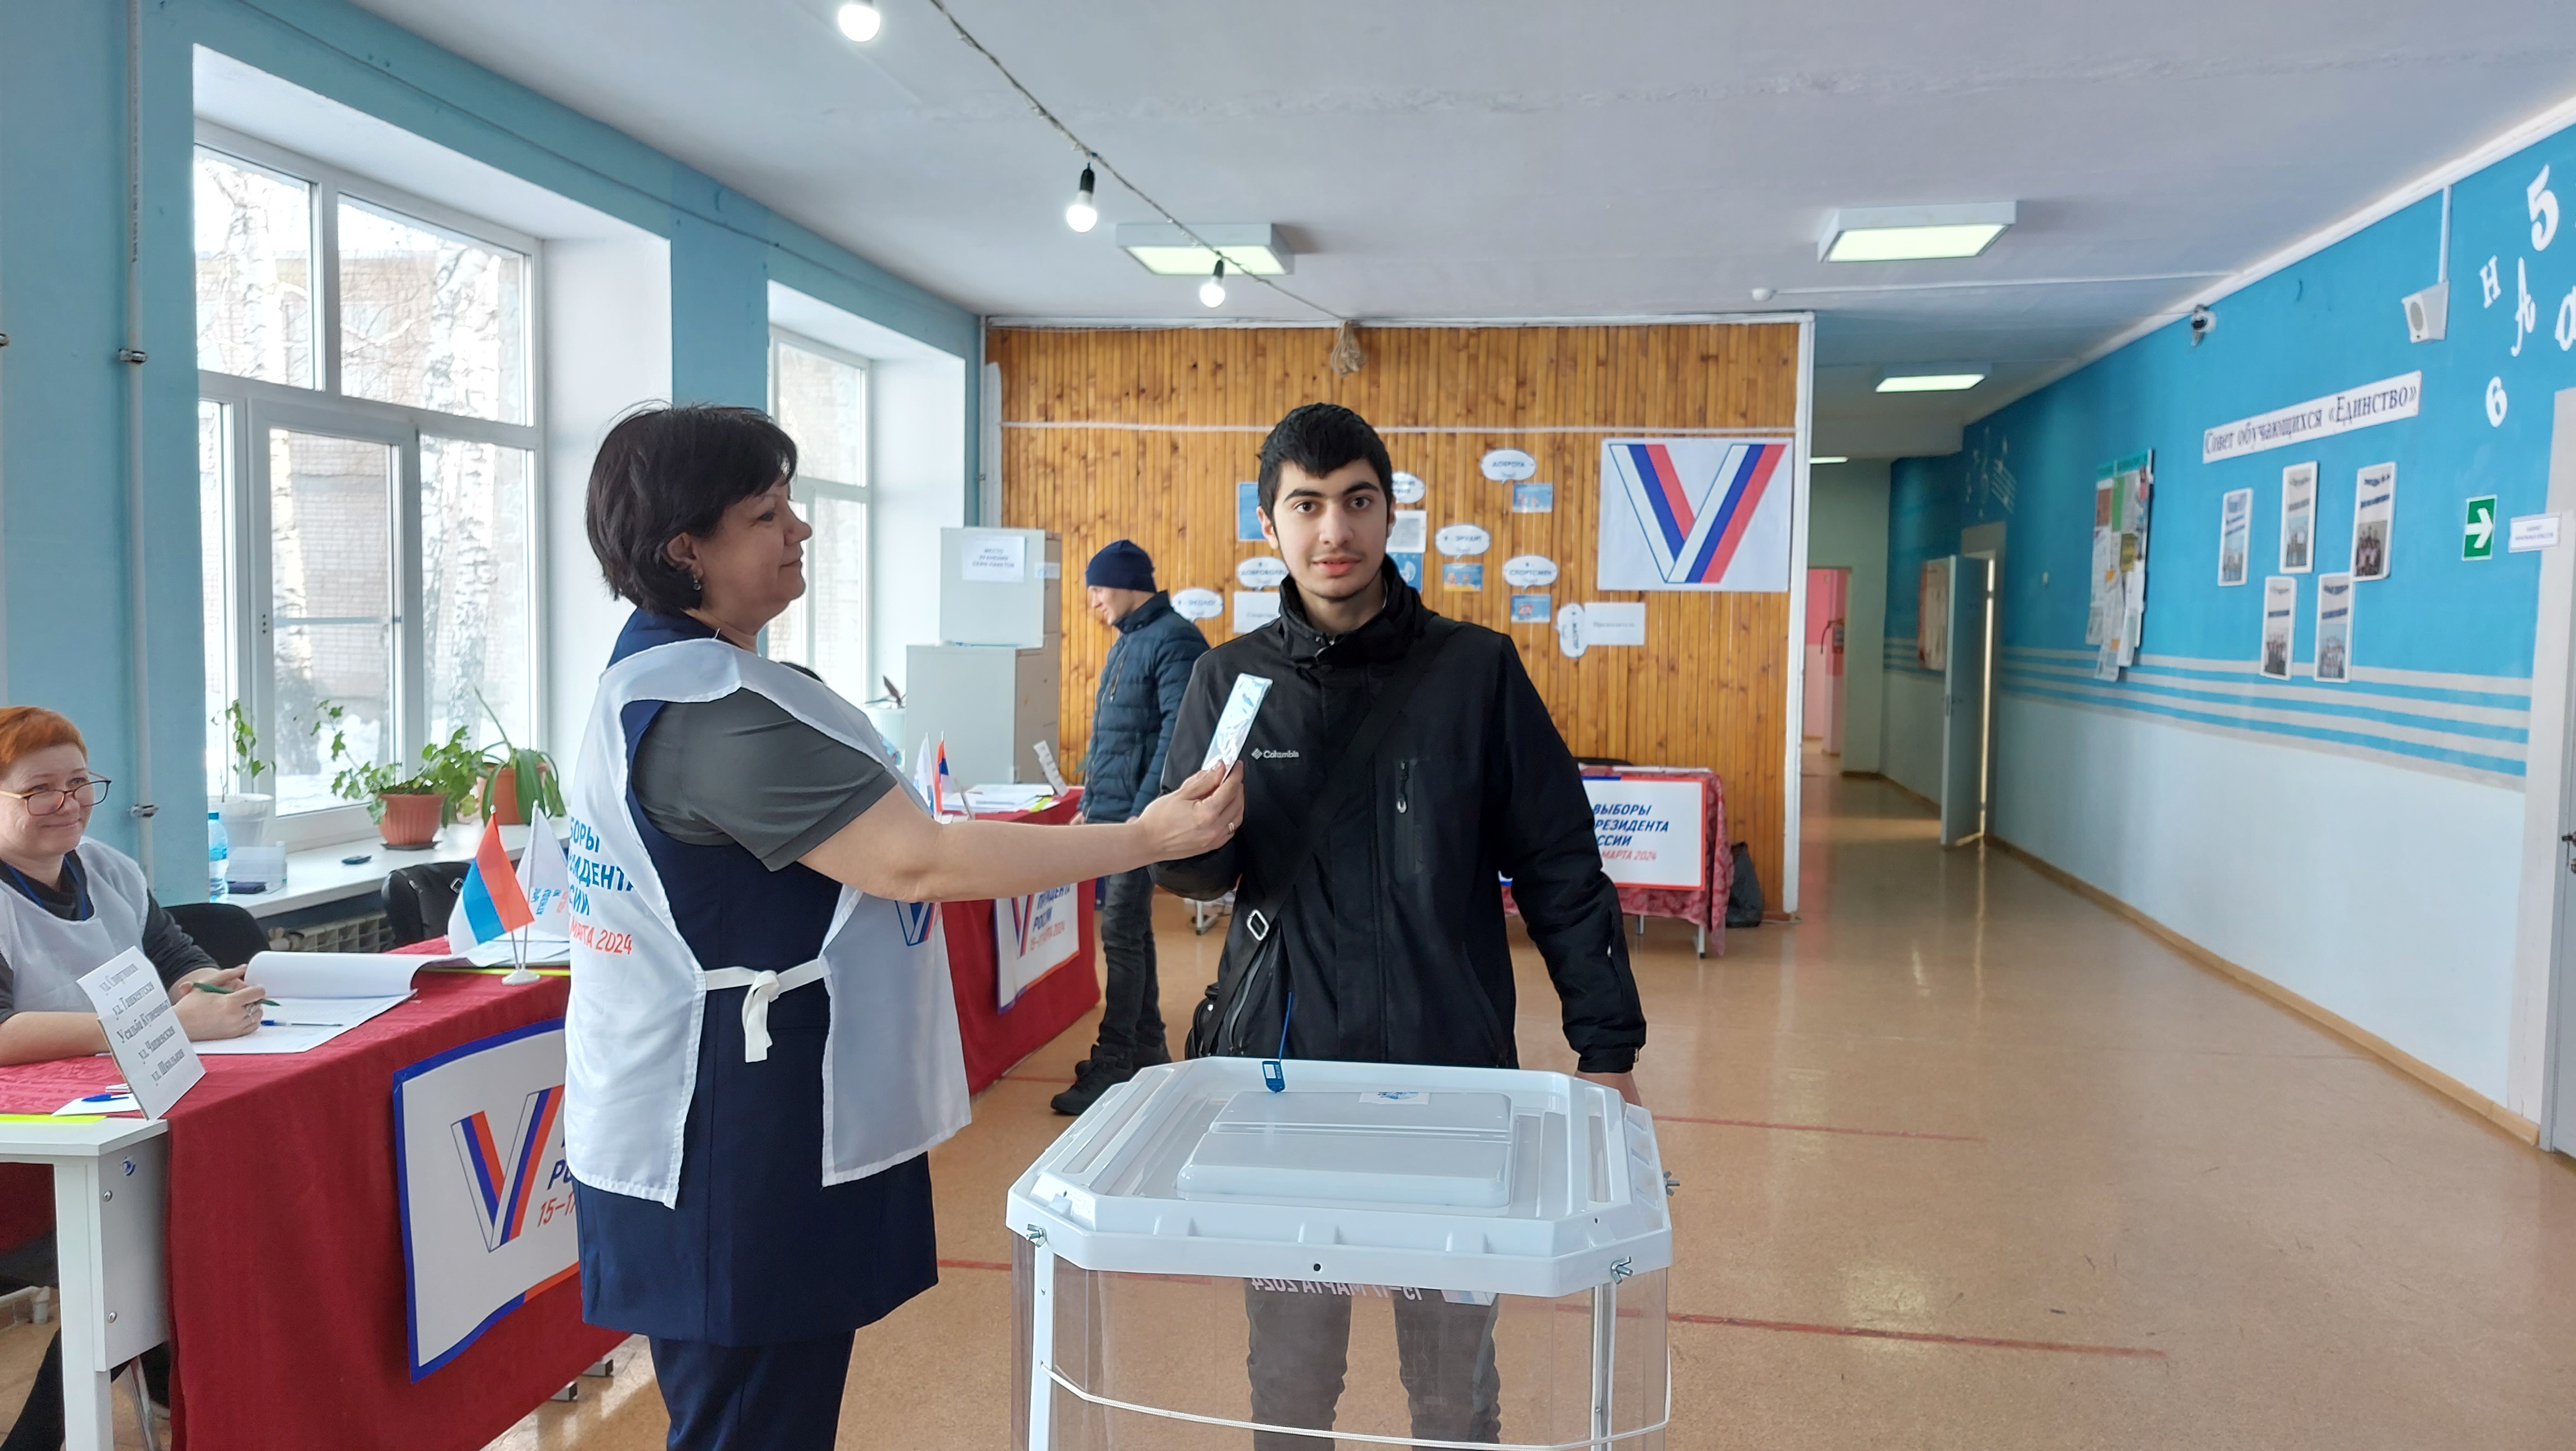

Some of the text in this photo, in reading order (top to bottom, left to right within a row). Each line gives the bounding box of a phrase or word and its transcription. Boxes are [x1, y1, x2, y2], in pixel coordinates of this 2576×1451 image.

[2527, 164, 2560, 252] 5
[2485, 376, 2507, 427] 6
[2205, 431, 2234, 455] Совет
[2328, 384, 2417, 426] «Единство»
[1263, 749, 1300, 758] Columbia
[1593, 804, 1652, 816] ВЫБОРЫ
[570, 816, 600, 853] БОРЫ
[1594, 819, 1669, 832] РЕЗИДЕНТА
[1597, 834, 1633, 846] ССИИ
[1601, 850, 1657, 860] МАРТА 2024
[595, 928, 632, 955] 2024
